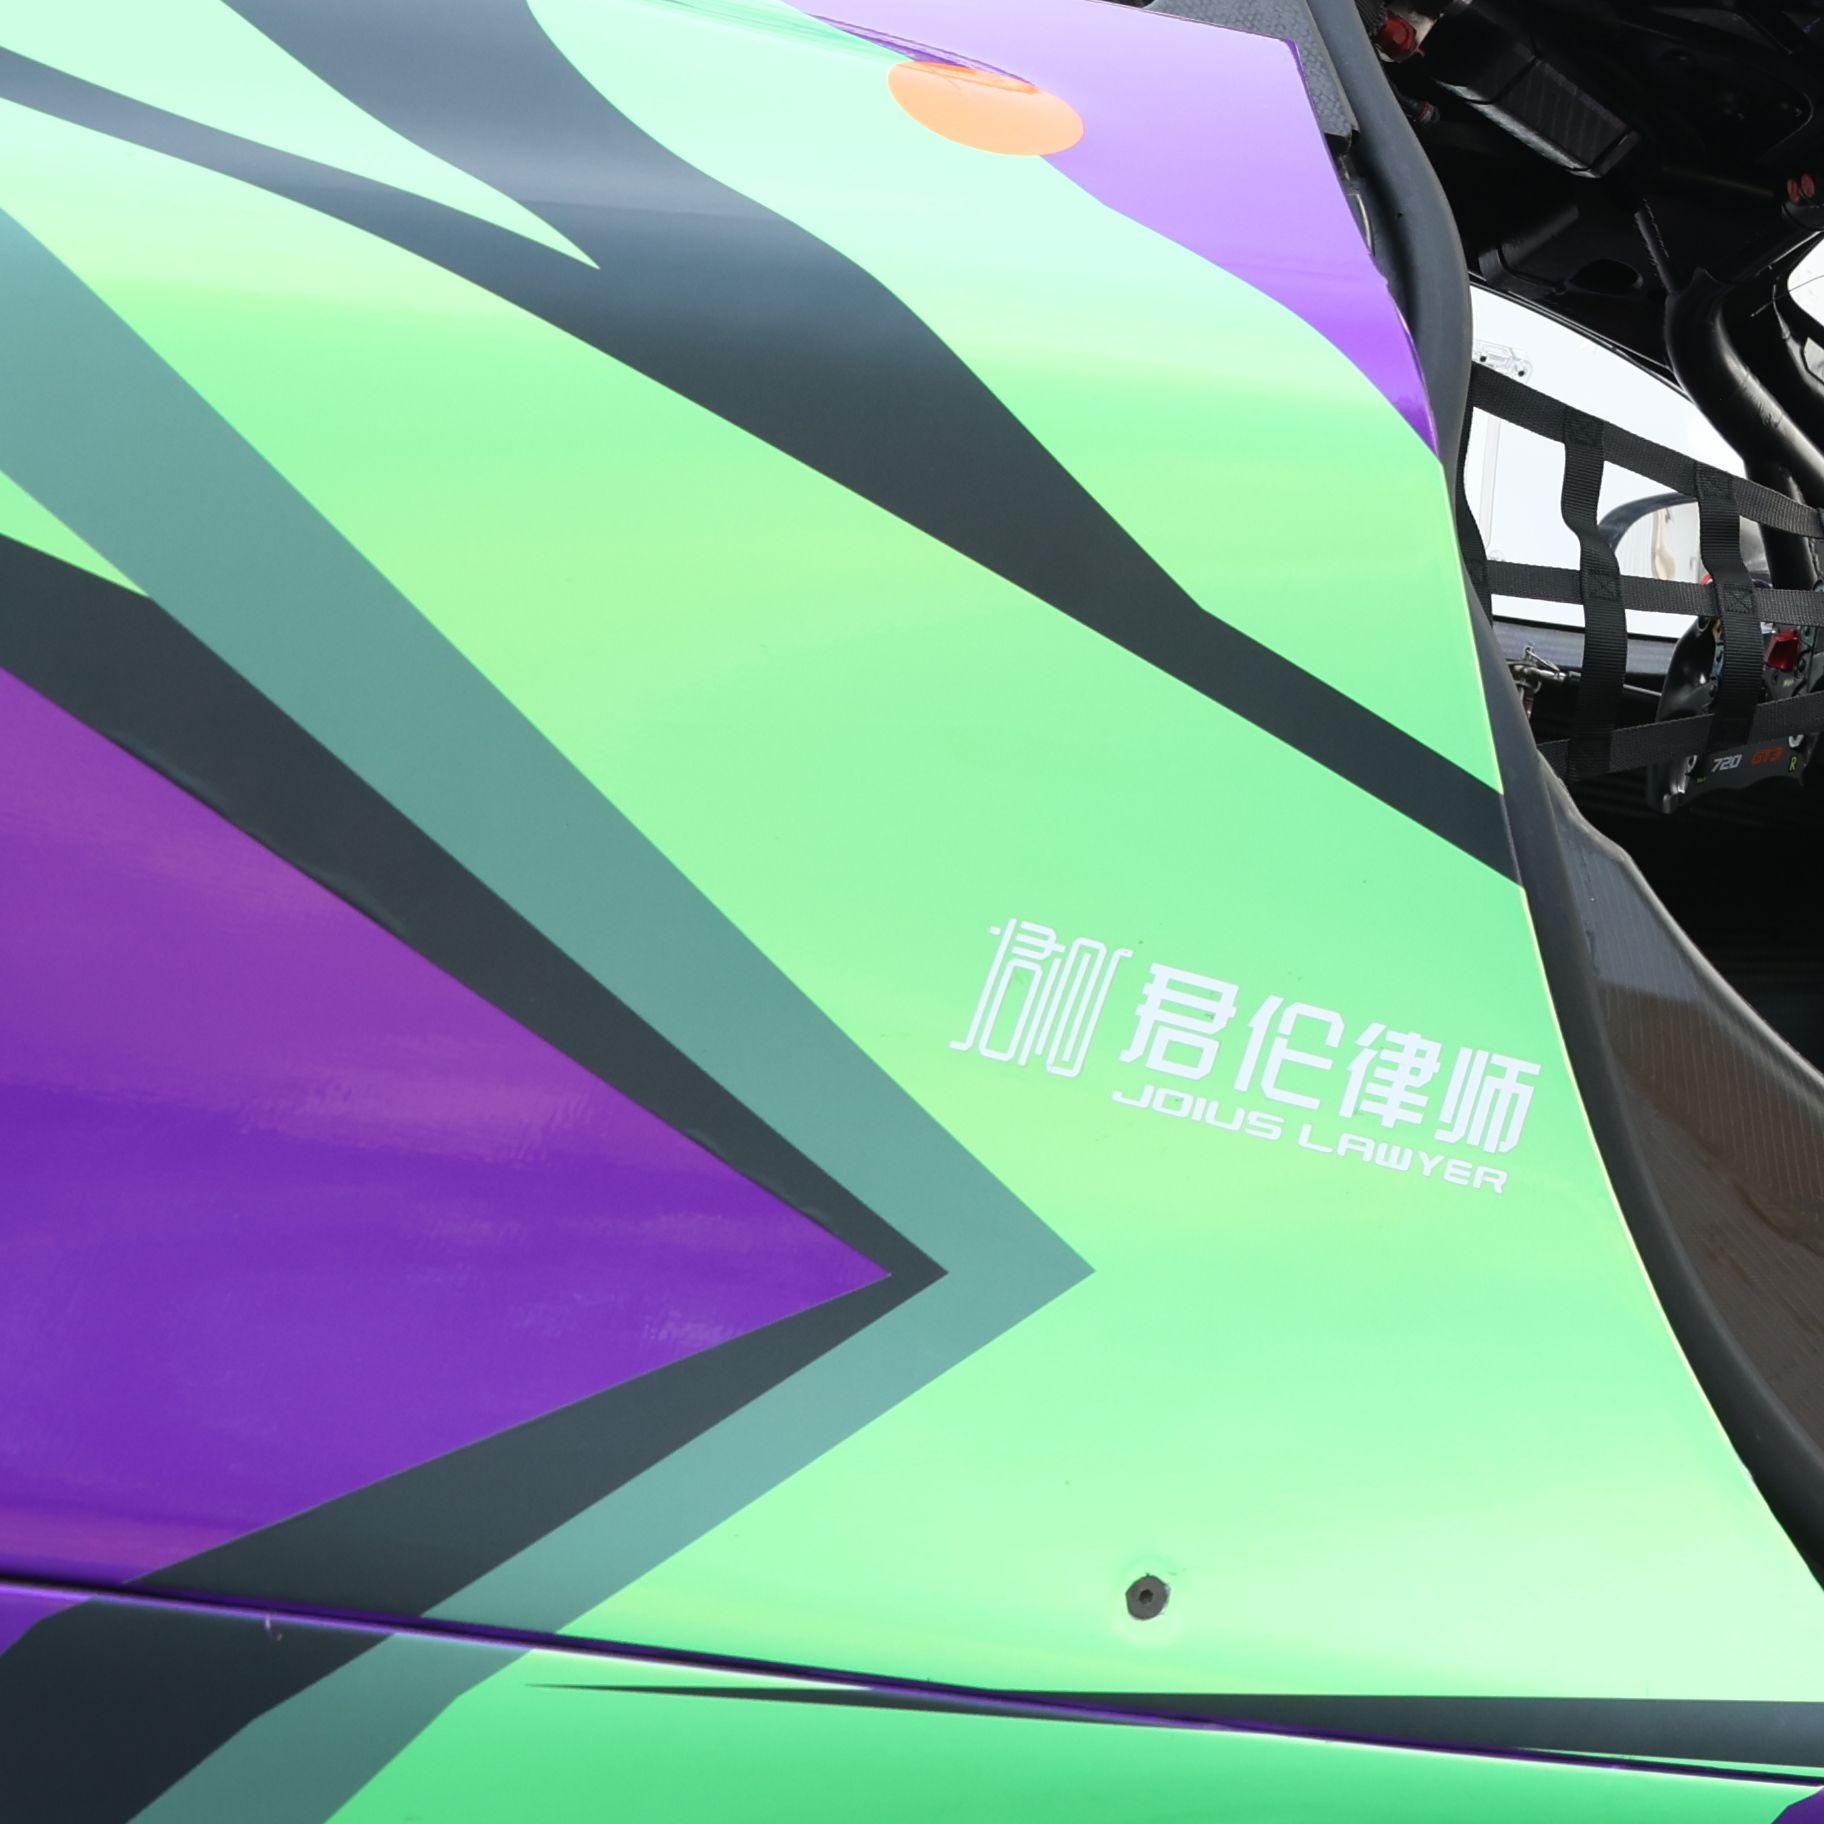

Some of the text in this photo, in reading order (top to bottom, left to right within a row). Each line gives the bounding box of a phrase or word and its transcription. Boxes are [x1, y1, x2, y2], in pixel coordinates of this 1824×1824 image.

[1120, 963, 1541, 1154] 君伦律师
[1112, 1084, 1508, 1194] JOIUS LAWYER
